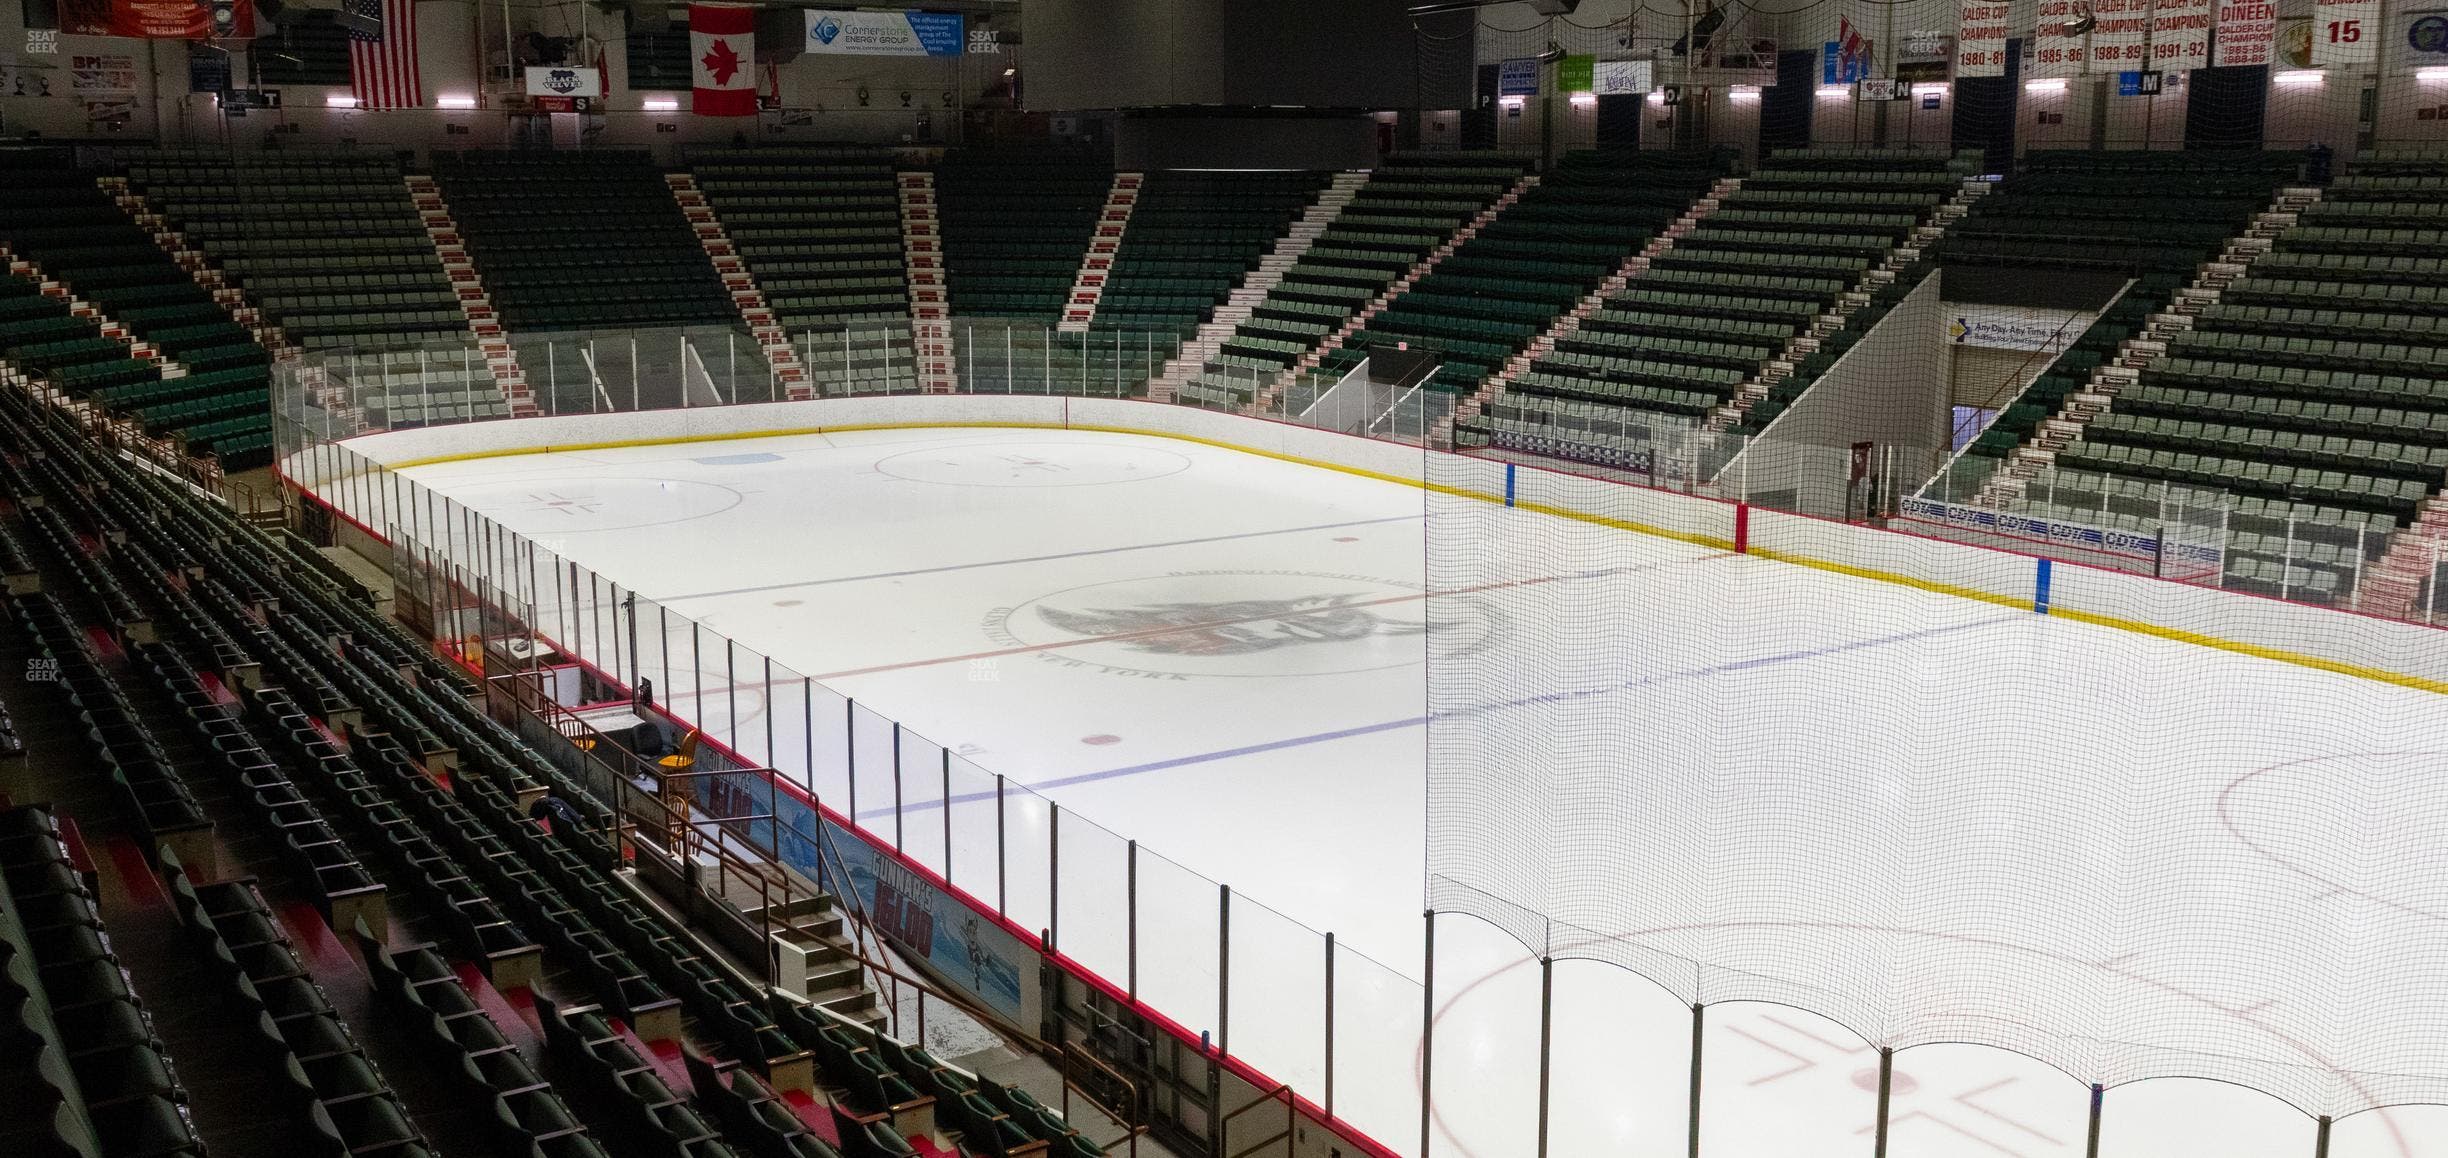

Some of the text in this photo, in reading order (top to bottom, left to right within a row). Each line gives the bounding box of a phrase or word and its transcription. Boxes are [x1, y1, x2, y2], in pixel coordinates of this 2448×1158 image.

[2040, 2, 2068, 16] CALDER
[2096, 0, 2145, 12] CALDER CUP
[2155, 0, 2188, 10] CALDER
[1963, 6, 2008, 20] CALDER CUP
[2221, 4, 2274, 22] DINEEN
[2094, 18, 2145, 34] CHAMPIONS
[2154, 14, 2209, 31] CHAMPIONS
[2218, 23, 2274, 35] CALDER CUP
[844, 24, 908, 36] Cornerstone
[1961, 26, 2007, 40] CHAMPIONS
[2327, 20, 2361, 43] 15
[2218, 33, 2273, 44] CHAMPION
[2038, 48, 2083, 63] 1985-86
[2094, 45, 2141, 60] 1988-89
[2153, 41, 2205, 58] 1991-92
[2224, 45, 2266, 55] 1985-86
[1960, 51, 2004, 65] 1980-81
[2223, 55, 2265, 64] 1988-89
[1503, 62, 1535, 72] SAWYER
[1897, 82, 1909, 97] N
[2142, 75, 2157, 91] M
[263, 93, 277, 106] T
[576, 98, 587, 110] S
[1482, 96, 1490, 107] P
[1975, 322, 1990, 332] Any
[2009, 326, 2024, 336] Any
[1902, 499, 1938, 514] CDTA
[1948, 506, 1987, 523] CDTA
[1998, 514, 2038, 532] CDTA
[2050, 524, 2093, 541] CDTA
[2105, 532, 2149, 550] CDTA
[1098, 667, 1188, 681] YORK
[707, 747, 751, 796] GUNNAR'S
[872, 850, 933, 913] GUNNAR'S
[873, 880, 934, 959] IGLOO
